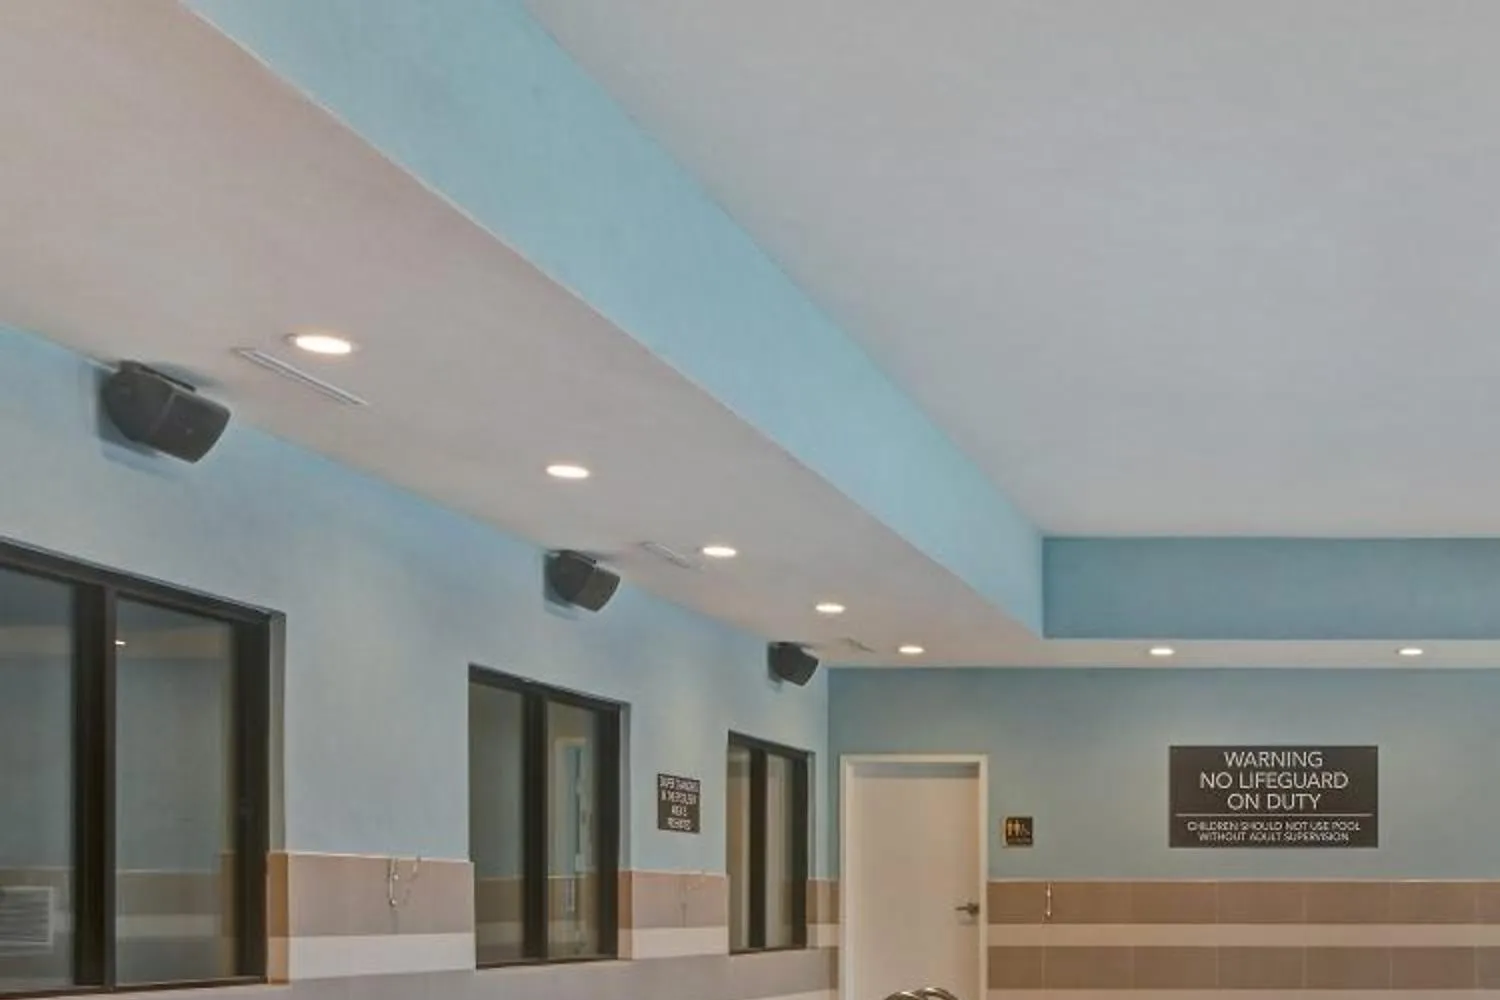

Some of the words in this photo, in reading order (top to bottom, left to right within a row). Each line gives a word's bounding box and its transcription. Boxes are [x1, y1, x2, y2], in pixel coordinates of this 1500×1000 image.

[1223, 751, 1324, 768] WARNING
[1199, 772, 1233, 789] NO
[1239, 772, 1349, 789] LIFEGUARD
[1227, 793, 1260, 810] ON
[1267, 793, 1322, 810] DUTY
